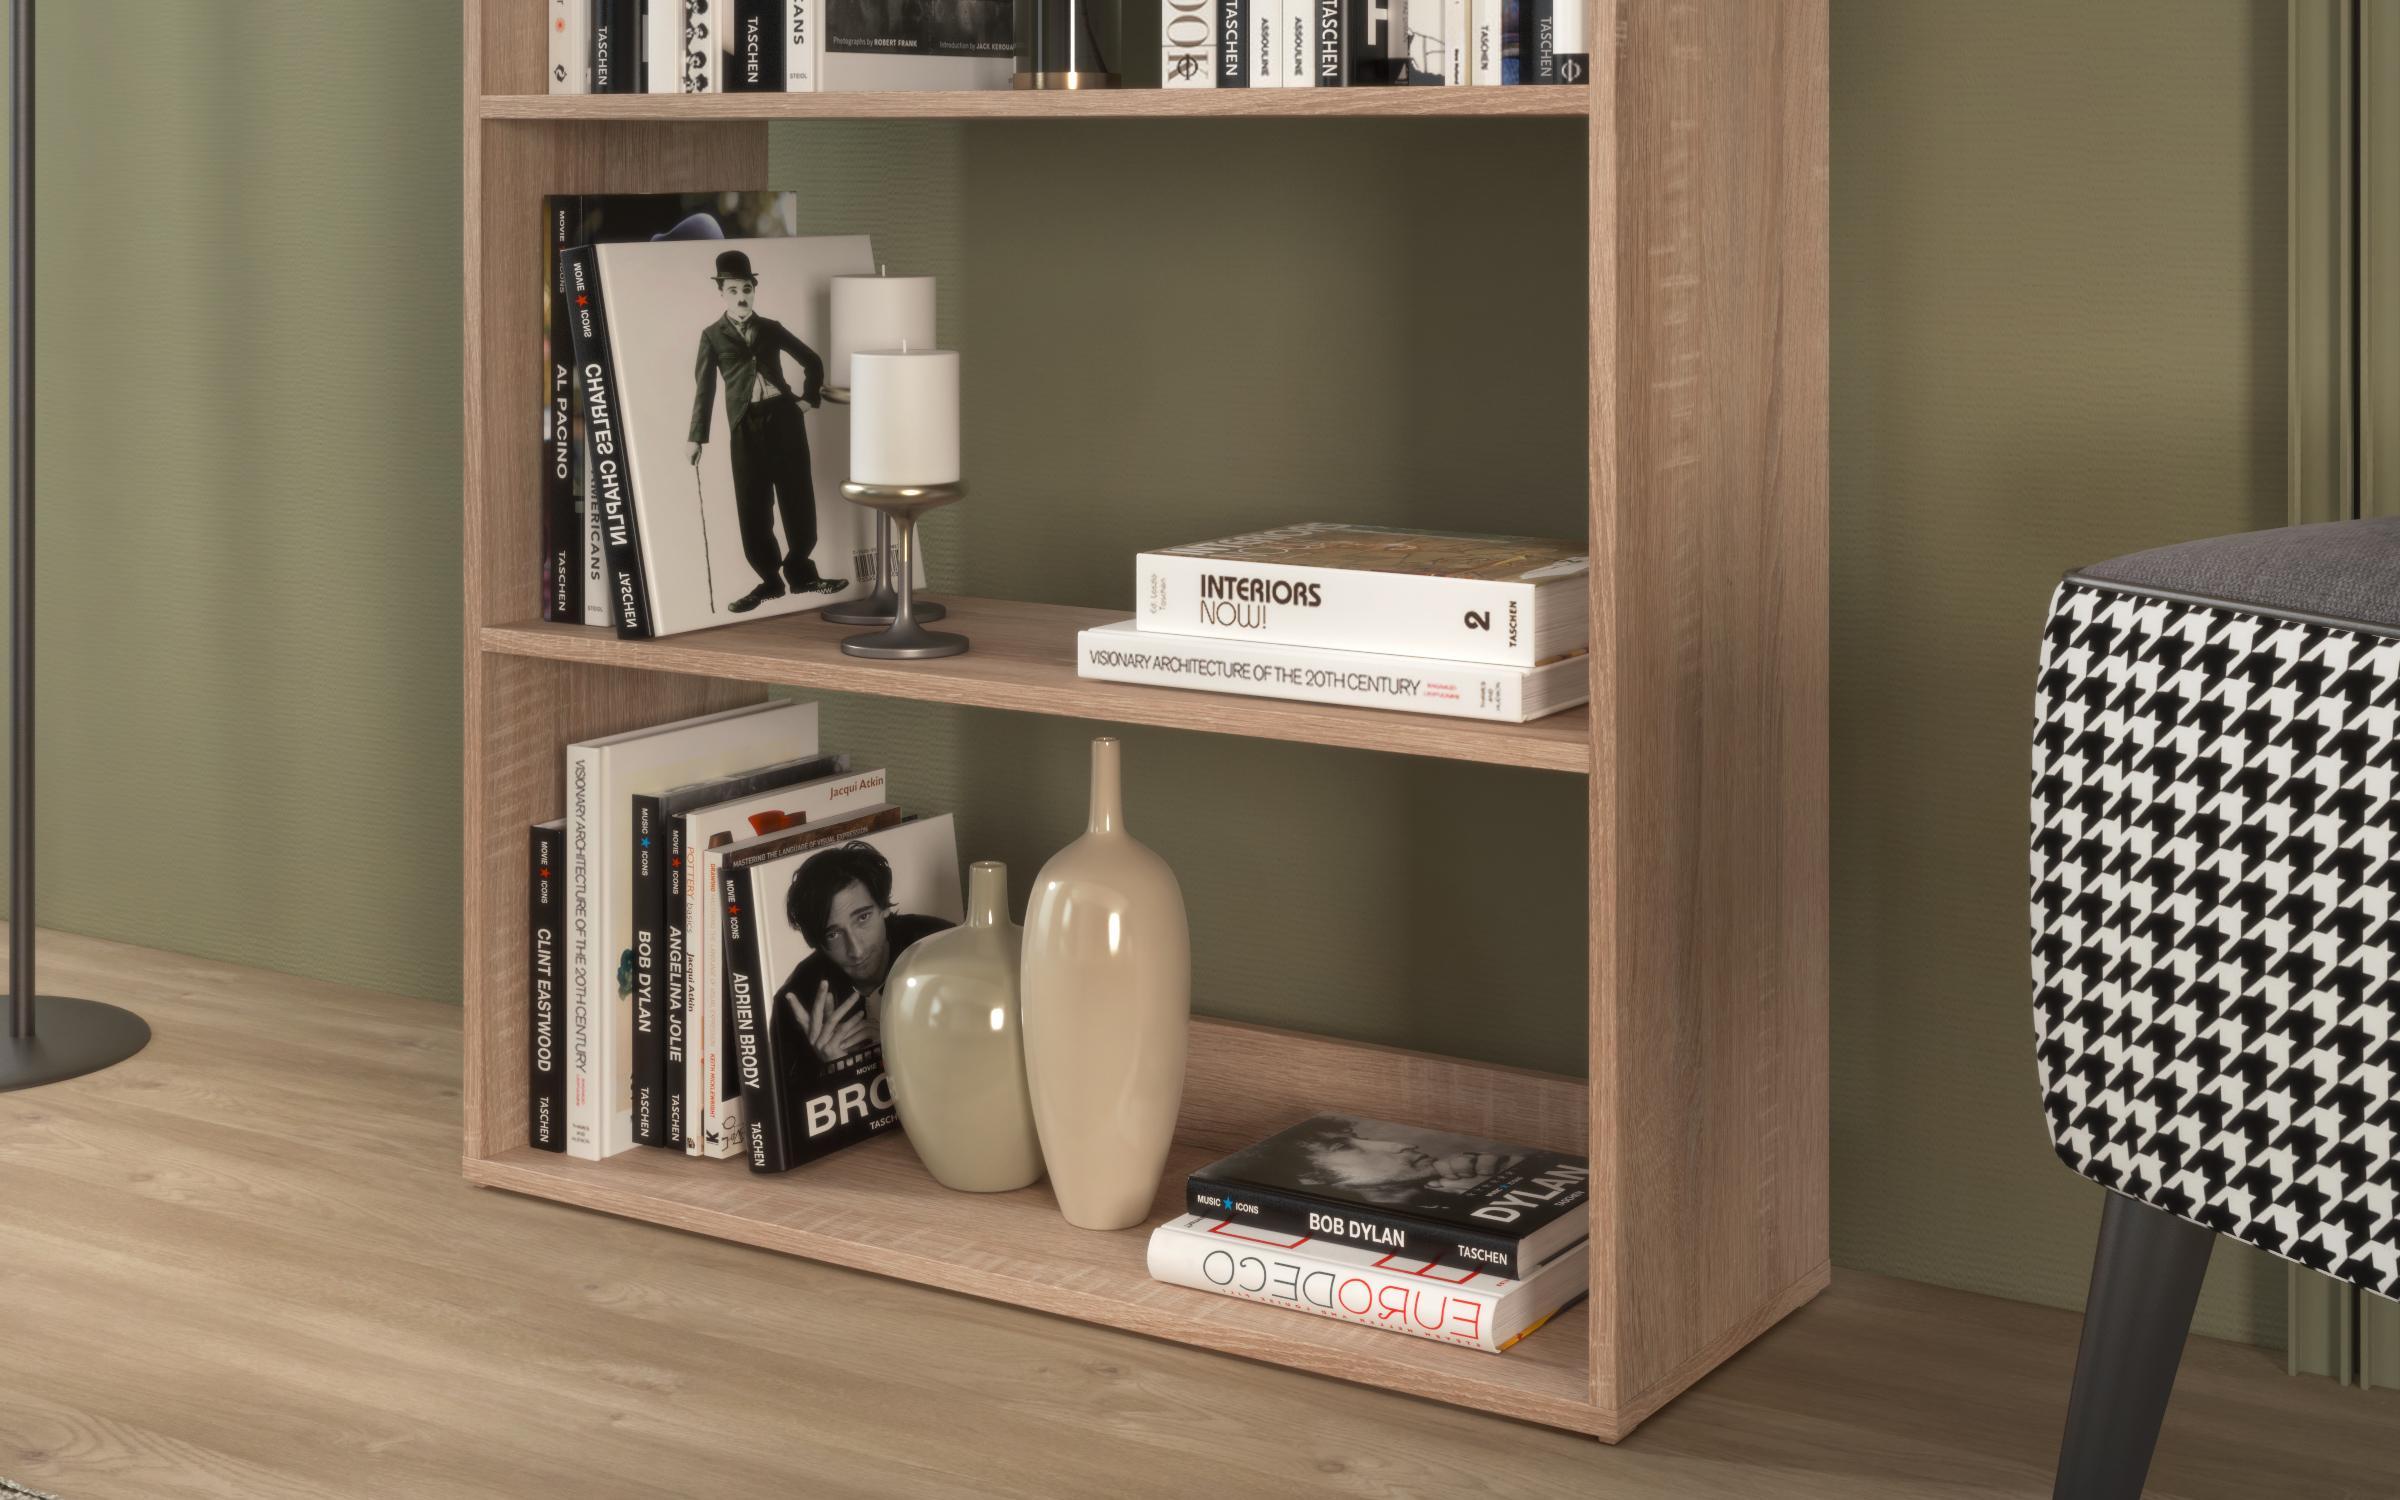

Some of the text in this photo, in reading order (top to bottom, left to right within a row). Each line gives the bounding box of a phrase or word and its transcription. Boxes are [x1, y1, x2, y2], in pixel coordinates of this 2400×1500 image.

[794, 0, 805, 46] ANS
[874, 38, 897, 47] ROBERT
[897, 40, 917, 48] FRANK
[976, 42, 991, 51] JACK
[1225, 0, 1238, 76] TASCHEN
[1260, 17, 1269, 76] ASSOULINE
[1294, 16, 1303, 76] ASSOULINE
[1322, 0, 1338, 77] TASCHEN
[1481, 25, 1489, 70] TASCHEN
[1540, 16, 1553, 77] TASCHEN
[598, 26, 608, 85] TASCHEN
[747, 16, 759, 83] TASCHEN
[556, 363, 568, 479] AL PACINO
[591, 470, 600, 581] MERICANS
[559, 550, 567, 611] TASCHEN
[1200, 574, 1322, 607] INTERIORS
[1200, 600, 1267, 630] NOW!
[1464, 611, 1490, 631] 2
[1509, 600, 1517, 647] TASCHEN
[1089, 650, 1151, 670] VISIONARY
[1153, 656, 1251, 680] ARCHITECTURE
[1253, 664, 1272, 681] OF
[1274, 666, 1303, 686] THE
[1306, 670, 1345, 688] 20TH
[1347, 673, 1421, 696] CENTURY
[575, 759, 586, 820] VISIONARY
[829, 776, 884, 801] Jacqui Atkin
[641, 807, 649, 877] MUSIC ICONS
[733, 854, 766, 868] MASTERING
[766, 851, 779, 861] THE
[779, 842, 809, 858] LANGUAGE
[575, 820, 586, 917] ARCHITECTURE
[687, 846, 696, 899] POTTERY
[575, 918, 586, 937] OF
[726, 879, 740, 940] MOVIE ICONS
[575, 940, 586, 965] THE
[537, 928, 552, 1072] CLINT EASTWOOD
[575, 967, 586, 1004] 20TH
[638, 931, 651, 1033] BOB DYLAN
[669, 926, 682, 1062] ANGELINA JOLIE
[686, 952, 695, 1012] Jacqui Atkin
[575, 1005, 586, 1073] CENTURY
[732, 972, 760, 1089] ADRIEN BRODY
[856, 1062, 878, 1075] MOVIE
[540, 1096, 549, 1142] TASCHEN
[641, 1087, 649, 1137] TASCHEN
[671, 1093, 680, 1141] TASCHEN
[751, 1122, 765, 1166] TASCHEN
[1197, 1194, 1259, 1215] MUSIC ICONS
[1470, 1164, 1589, 1223] DYLAN
[1309, 1211, 1405, 1248] BOB DYLAN
[1457, 1244, 1508, 1266] TASCHEN
